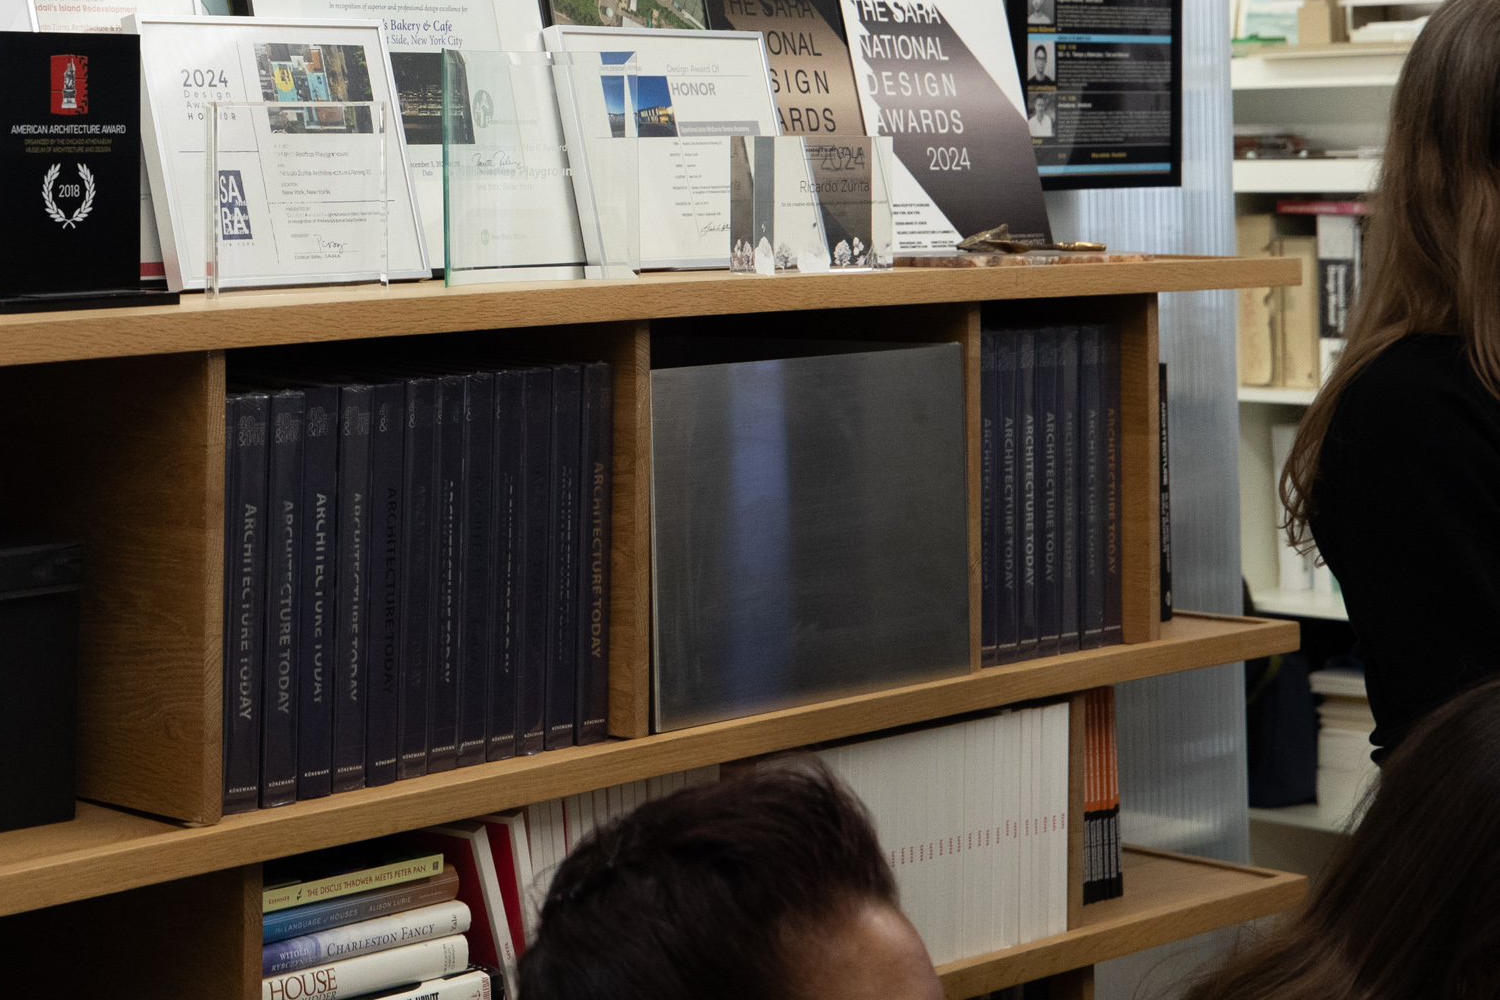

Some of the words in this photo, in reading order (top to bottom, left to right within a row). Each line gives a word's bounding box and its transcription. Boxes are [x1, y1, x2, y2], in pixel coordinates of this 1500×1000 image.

[59, 4, 81, 13] Island
[83, 5, 137, 14] Redevelopment
[335, 3, 361, 11] recognition
[397, 4, 423, 12] professional
[424, 5, 438, 13] design
[439, 5, 461, 13] excellence
[851, 0, 888, 23] THE
[892, 0, 941, 24] SARA
[390, 20, 420, 34] Bakery
[433, 20, 452, 35] Cafe
[391, 34, 409, 46] Side,
[411, 35, 427, 45] New
[429, 35, 446, 46] York
[447, 35, 463, 48] City
[767, 31, 823, 57] ONAL
[859, 34, 949, 61] NATIONAL
[180, 69, 228, 88] 2024
[666, 64, 688, 76] Design
[690, 65, 710, 73] Award
[711, 65, 719, 73] Of
[770, 68, 830, 95] SIGN
[184, 90, 231, 101] Design
[671, 82, 716, 96] HONOR
[867, 72, 957, 97] DESIGN
[11, 125, 48, 134] AMERICAN
[49, 125, 100, 134] ARCHITECTURE
[101, 124, 126, 134] AWARD
[877, 108, 964, 134] AWARDS
[927, 147, 971, 171] 2024
[59, 184, 80, 198] 2018
[800, 180, 838, 194] Ricardo
[841, 180, 870, 193] Zurita
[1024, 414, 1034, 528] ARCHITECTURE
[591, 461, 604, 598] ARCHITECTURE
[1024, 529, 1034, 586] TODAY
[1045, 530, 1055, 583] TODAY
[591, 599, 602, 658] TODAY
[278, 649, 290, 714] TODAY
[307, 888, 319, 897] THE
[320, 883, 342, 895] DISCUS
[344, 876, 373, 889] THROWER
[375, 872, 393, 886] MEETS
[394, 868, 412, 880] PETER
[413, 865, 426, 876] PAN
[284, 917, 322, 932] LANGUAGE
[329, 908, 358, 921] HOUSES
[327, 931, 397, 957] CHARLESTON
[401, 923, 435, 941] FANCY
[450, 913, 458, 932] Yale
[279, 947, 310, 961] WITOLD
[268, 967, 337, 1000] HOUSE
